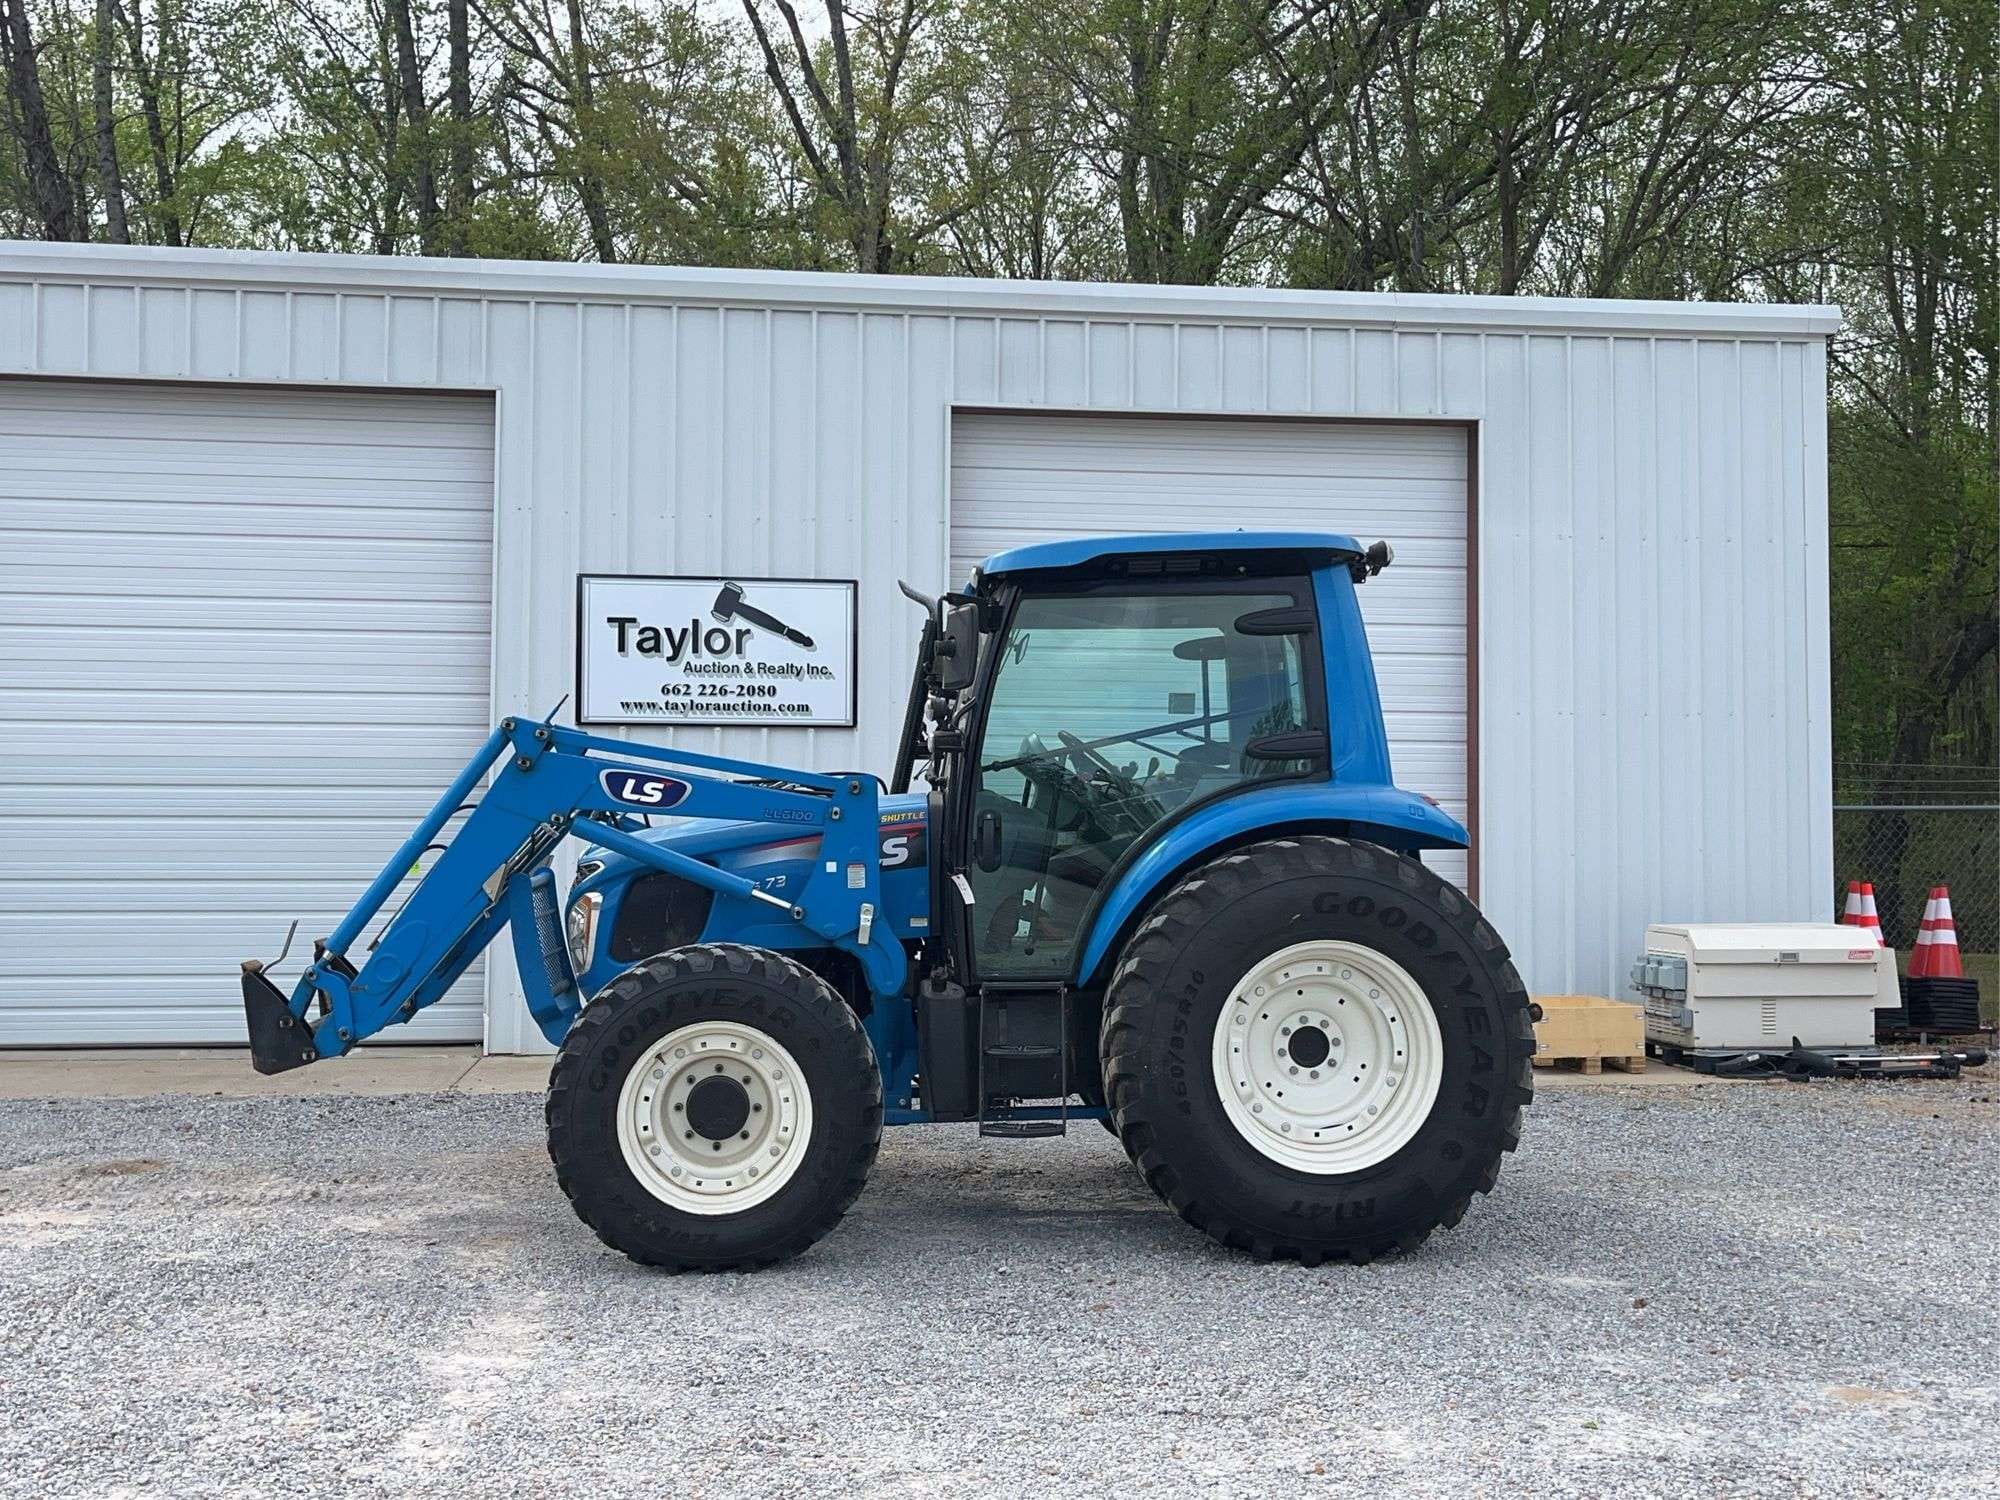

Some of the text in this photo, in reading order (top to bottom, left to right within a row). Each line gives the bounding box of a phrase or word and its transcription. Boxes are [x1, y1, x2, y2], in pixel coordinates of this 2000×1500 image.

[607, 617, 752, 662] Taylor
[683, 661, 833, 678] Auction & Realty Inc.
[660, 683, 777, 698] 662 226-2080
[620, 698, 811, 714] www.taylorauction.com
[622, 778, 665, 803] LS
[880, 811, 926, 823] SHUTTLE
[765, 875, 786, 889] 73
[1312, 891, 1494, 1117] GOODYEAR
[589, 988, 797, 1090] GOODYEAR
